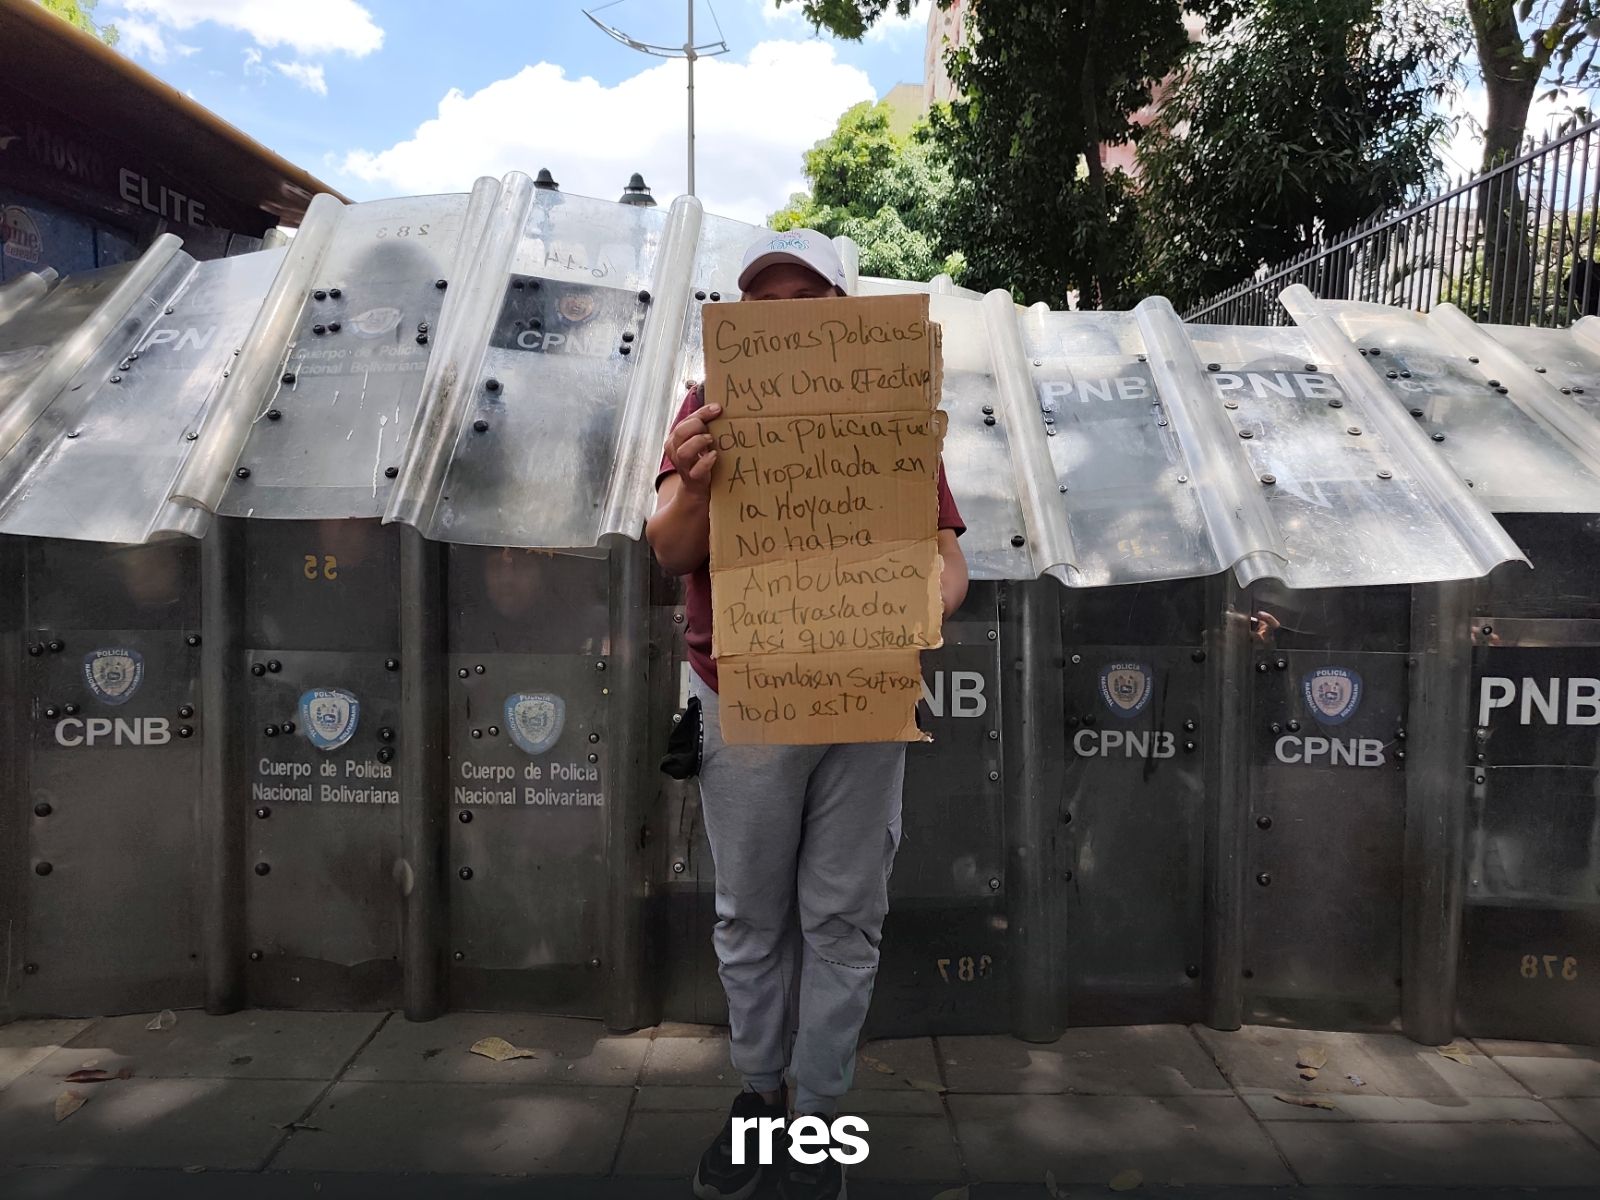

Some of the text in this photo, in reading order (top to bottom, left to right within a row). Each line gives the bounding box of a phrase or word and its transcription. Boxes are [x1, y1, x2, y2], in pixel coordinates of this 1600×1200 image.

[119, 167, 206, 227] ELITE
[716, 320, 822, 364] Señores
[725, 371, 784, 411] Ayer
[791, 370, 845, 396] Una
[1041, 376, 1149, 404] PNB
[1210, 373, 1344, 400] PNB
[718, 422, 757, 451] de
[757, 422, 785, 448] la
[728, 445, 926, 493] Atropellada en
[739, 502, 768, 523] la
[735, 531, 776, 557] No
[778, 590, 908, 626] trasladar
[798, 629, 846, 654] que
[852, 625, 931, 650] Ustedes
[727, 698, 797, 724] todo
[1478, 676, 1600, 726] PNB
[54, 717, 172, 746] CPNB
[1073, 728, 1176, 759] CPNB
[1274, 735, 1386, 767] CPNB
[259, 758, 312, 780] Cuerpo
[320, 759, 337, 777] de
[461, 761, 515, 783] Cuerpo
[524, 762, 541, 780] de
[252, 783, 399, 804] Nacional Bolivariana
[455, 786, 605, 807] Nacional Bolivariana
